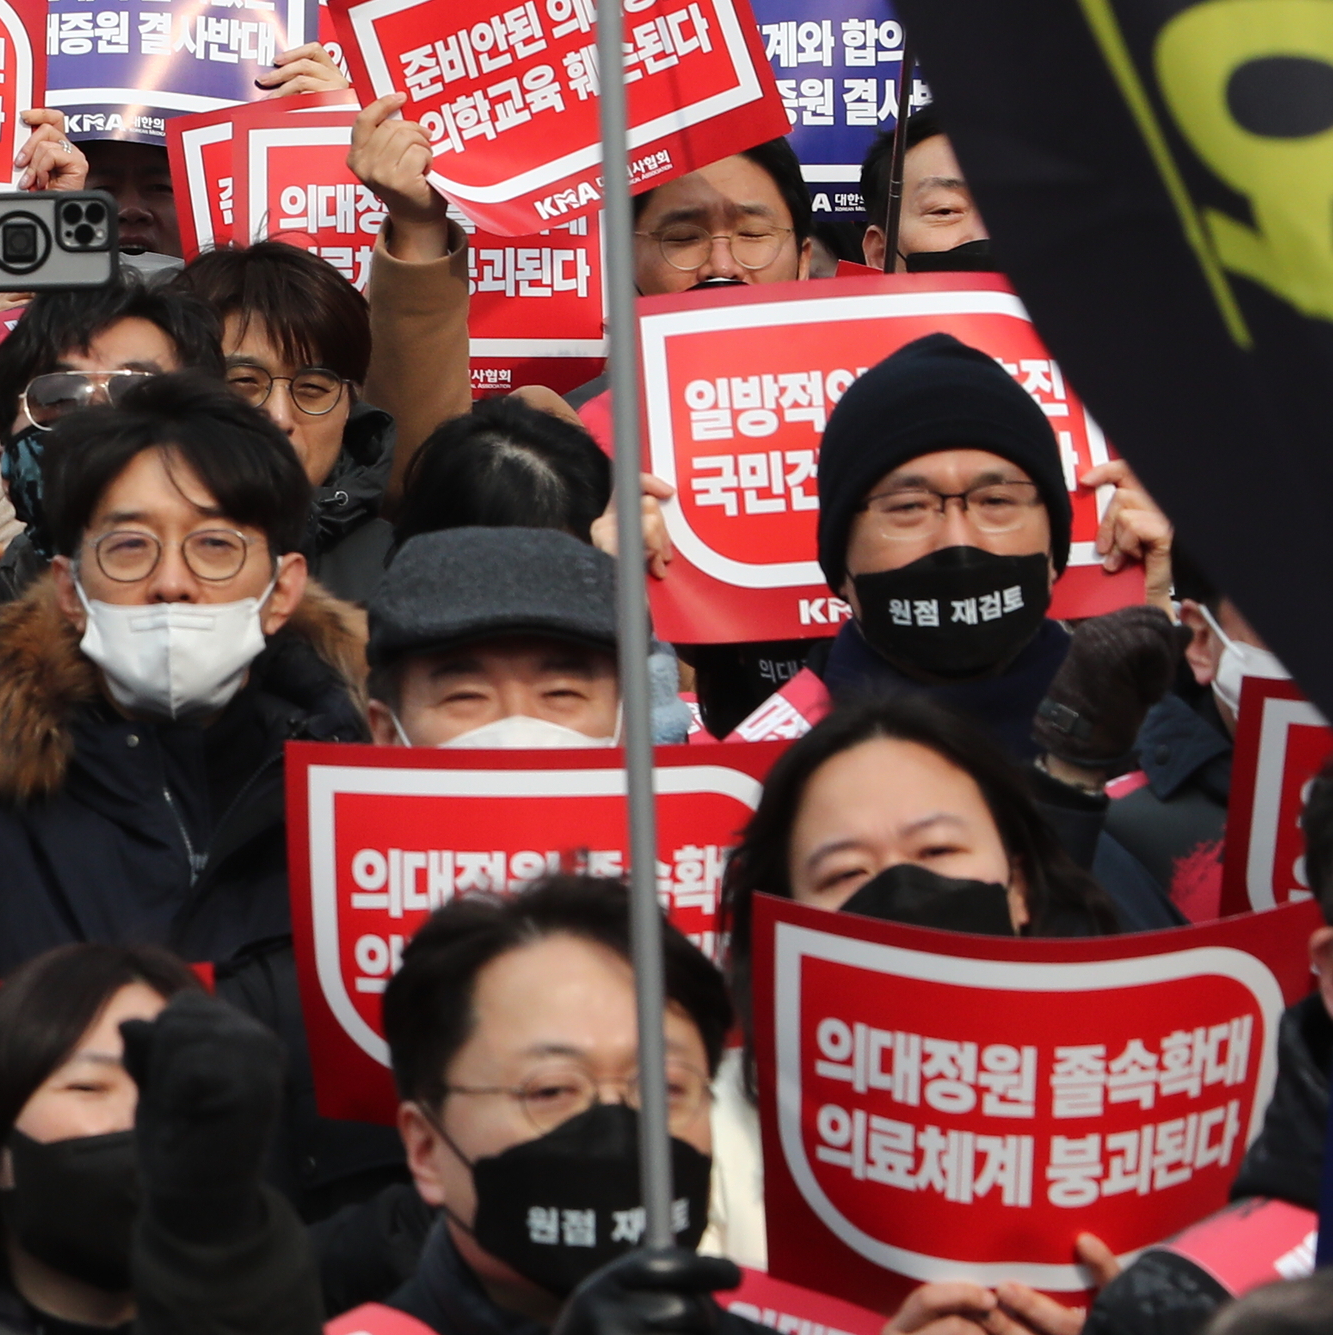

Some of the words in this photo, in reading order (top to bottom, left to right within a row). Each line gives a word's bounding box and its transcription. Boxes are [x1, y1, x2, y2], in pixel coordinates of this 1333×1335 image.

[139, 10, 276, 67] 결사반대
[65, 112, 125, 135] KMA
[534, 181, 600, 221] KMA
[888, 597, 940, 628] 원점
[950, 583, 1025, 626] 재검토
[814, 1016, 1037, 1119] 의대정원
[1049, 1013, 1254, 1121] 졸속확대
[814, 1102, 1031, 1208] 의료체계
[1044, 1100, 1240, 1210] 붕괴된다
[526, 1205, 596, 1248] 원점
